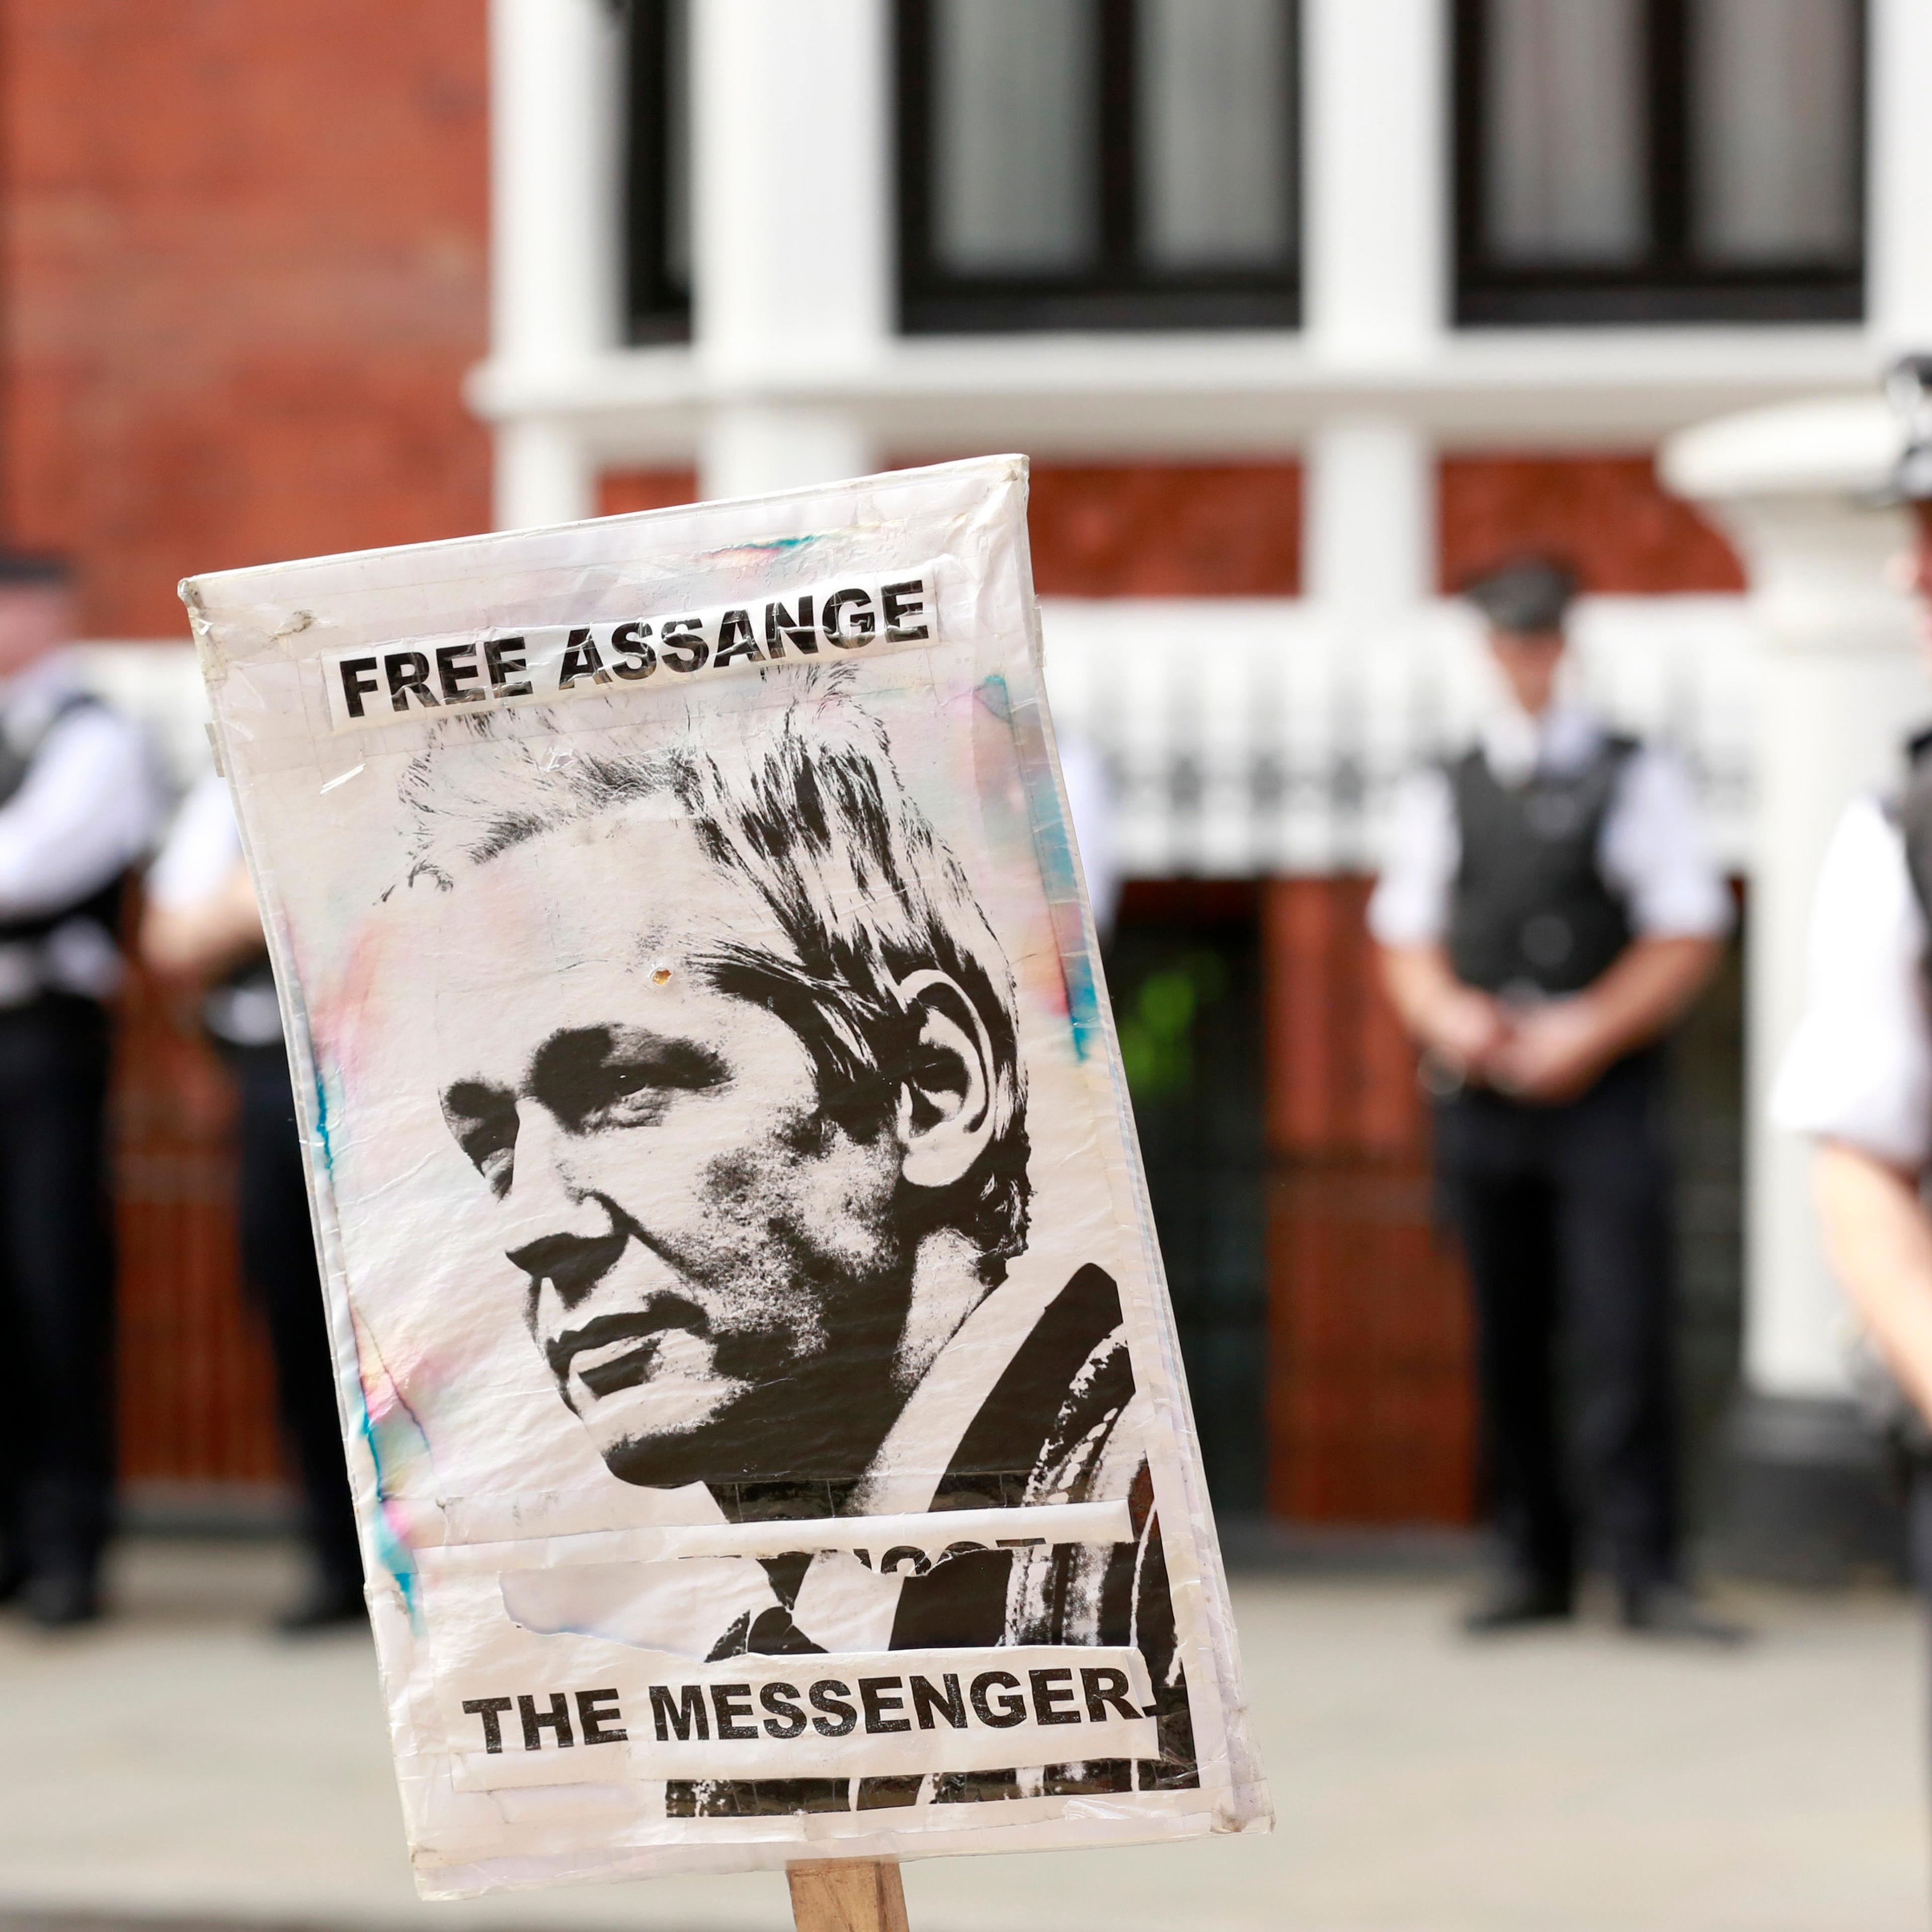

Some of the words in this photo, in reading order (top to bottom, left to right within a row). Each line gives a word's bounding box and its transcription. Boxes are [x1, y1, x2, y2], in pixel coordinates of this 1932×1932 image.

[340, 636, 532, 717] FREE
[558, 580, 930, 690] ASSANGE
[462, 1688, 628, 1754] THE
[649, 1668, 1144, 1741] MESSENGER
